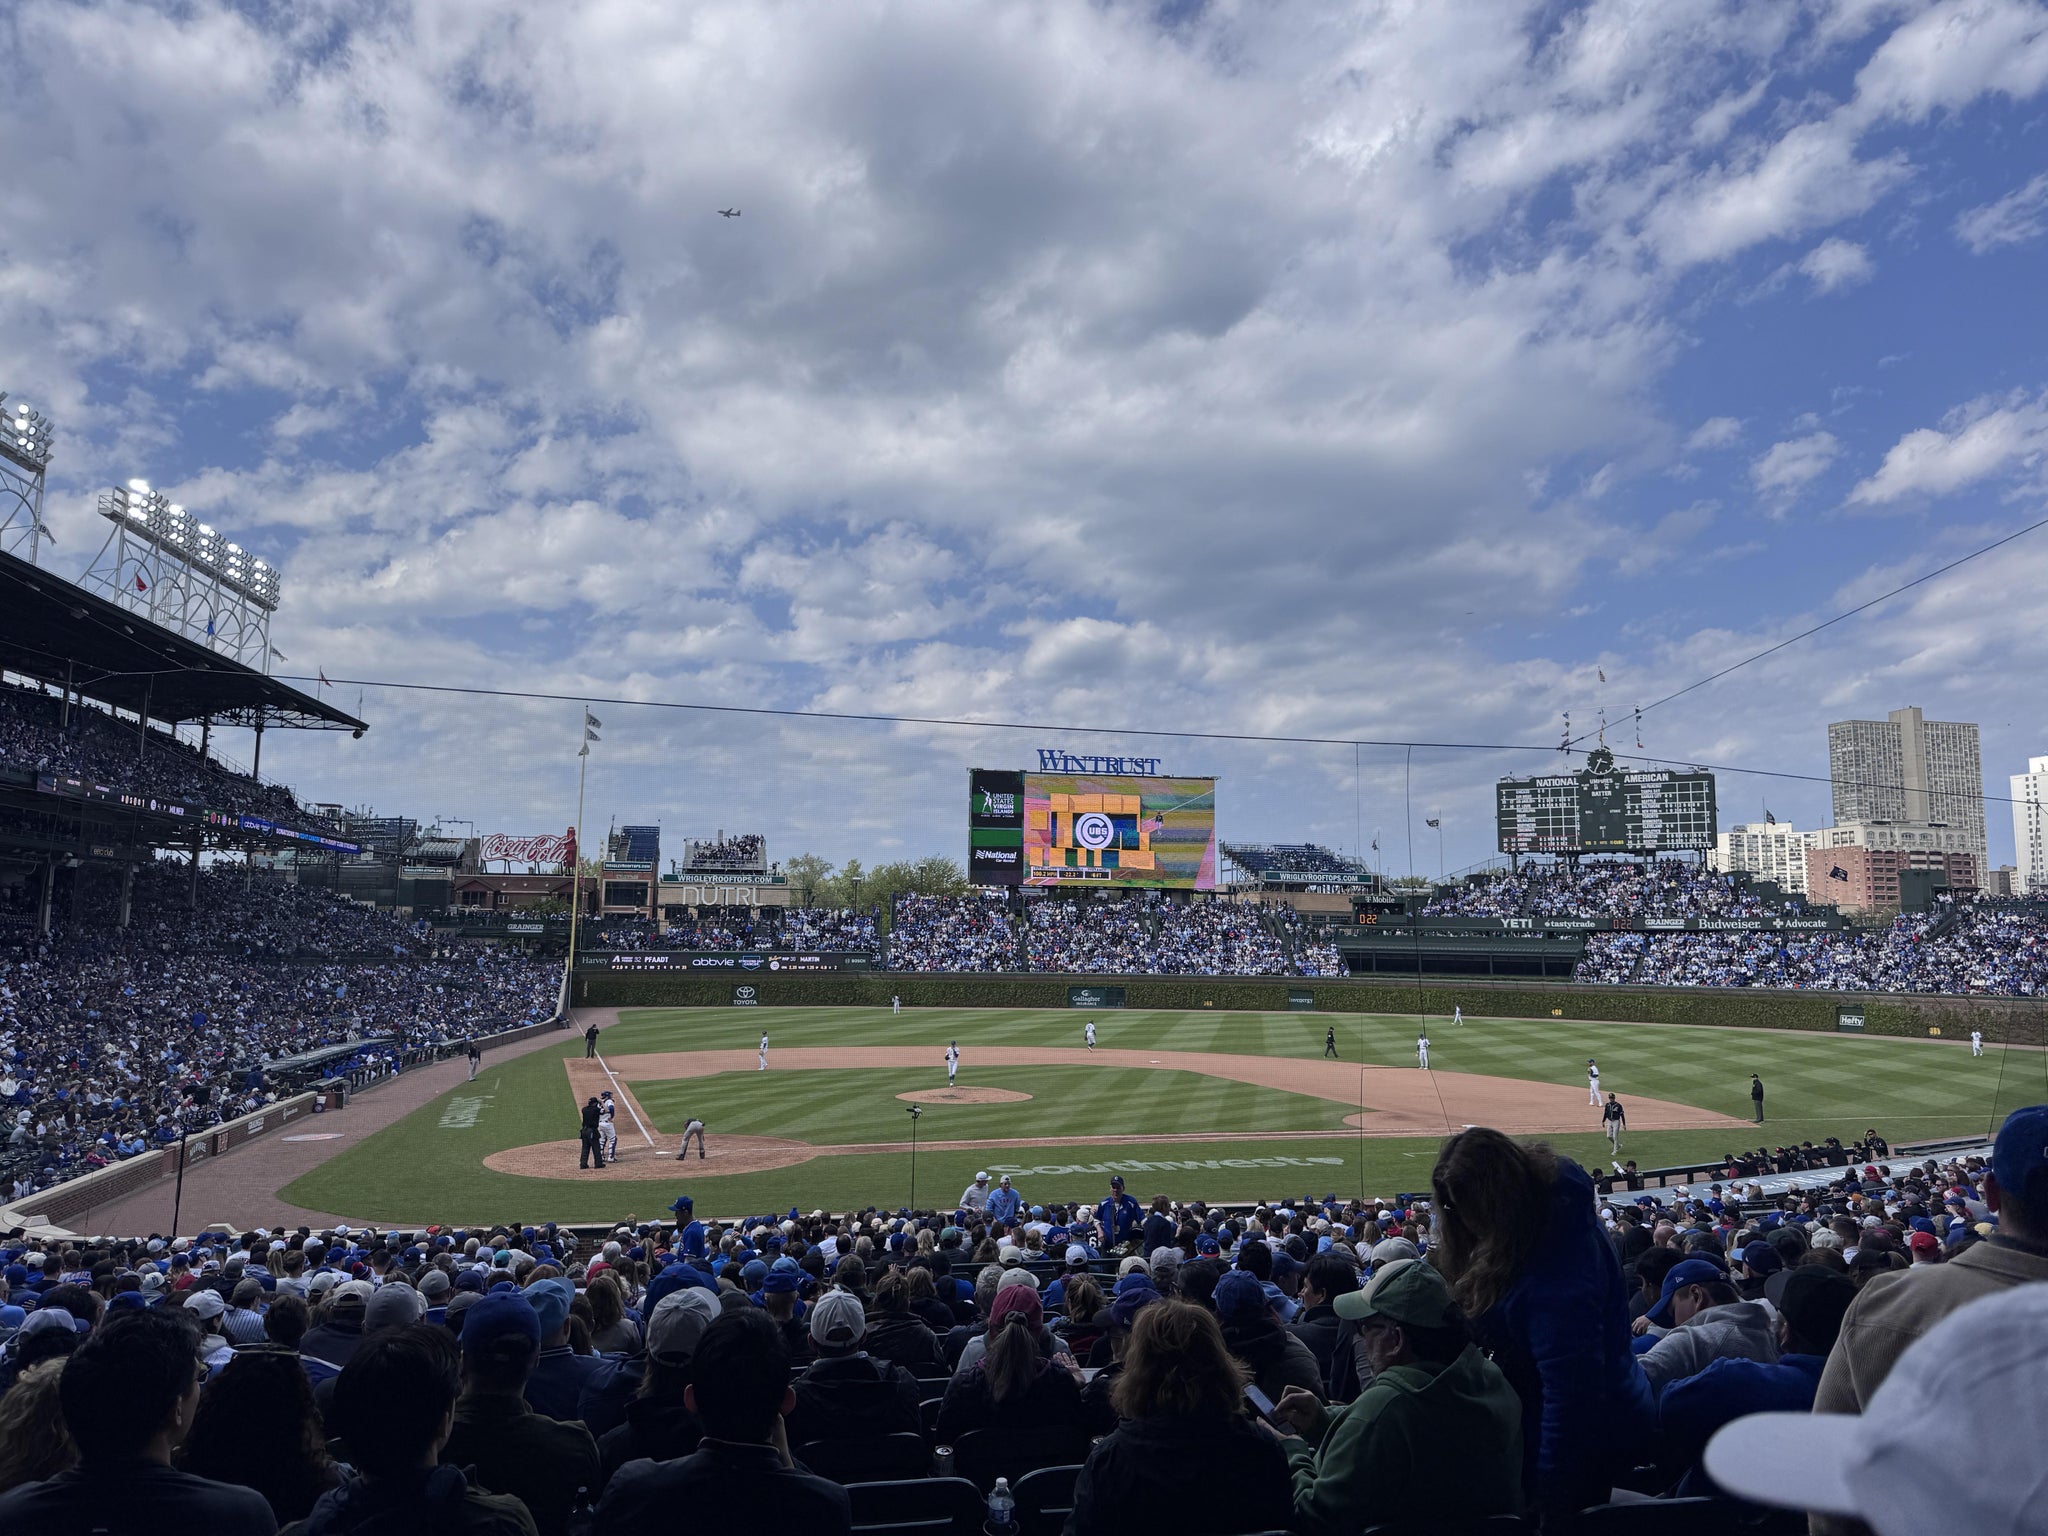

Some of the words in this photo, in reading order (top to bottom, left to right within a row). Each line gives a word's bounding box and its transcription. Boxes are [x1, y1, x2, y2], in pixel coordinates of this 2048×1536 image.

[1037, 749, 1161, 775] WINTRUST
[1536, 778, 1579, 787] NATIONAL
[1624, 773, 1668, 783] AMERICAN
[480, 833, 573, 864] Coca-Cola
[985, 850, 1017, 859] National
[678, 874, 772, 884] WRIGLEYROOFTOPS.COM
[1280, 873, 1358, 882] WRIGLEYROOFTOPS.COM
[1500, 919, 1532, 928] YETI
[1550, 920, 1595, 929] tastytrade
[1785, 919, 1827, 928] Advocate
[582, 956, 608, 965] Harvey
[692, 958, 734, 966] abbvie
[1841, 1016, 1863, 1026] Hefty
[986, 1156, 1314, 1176] Southwest
